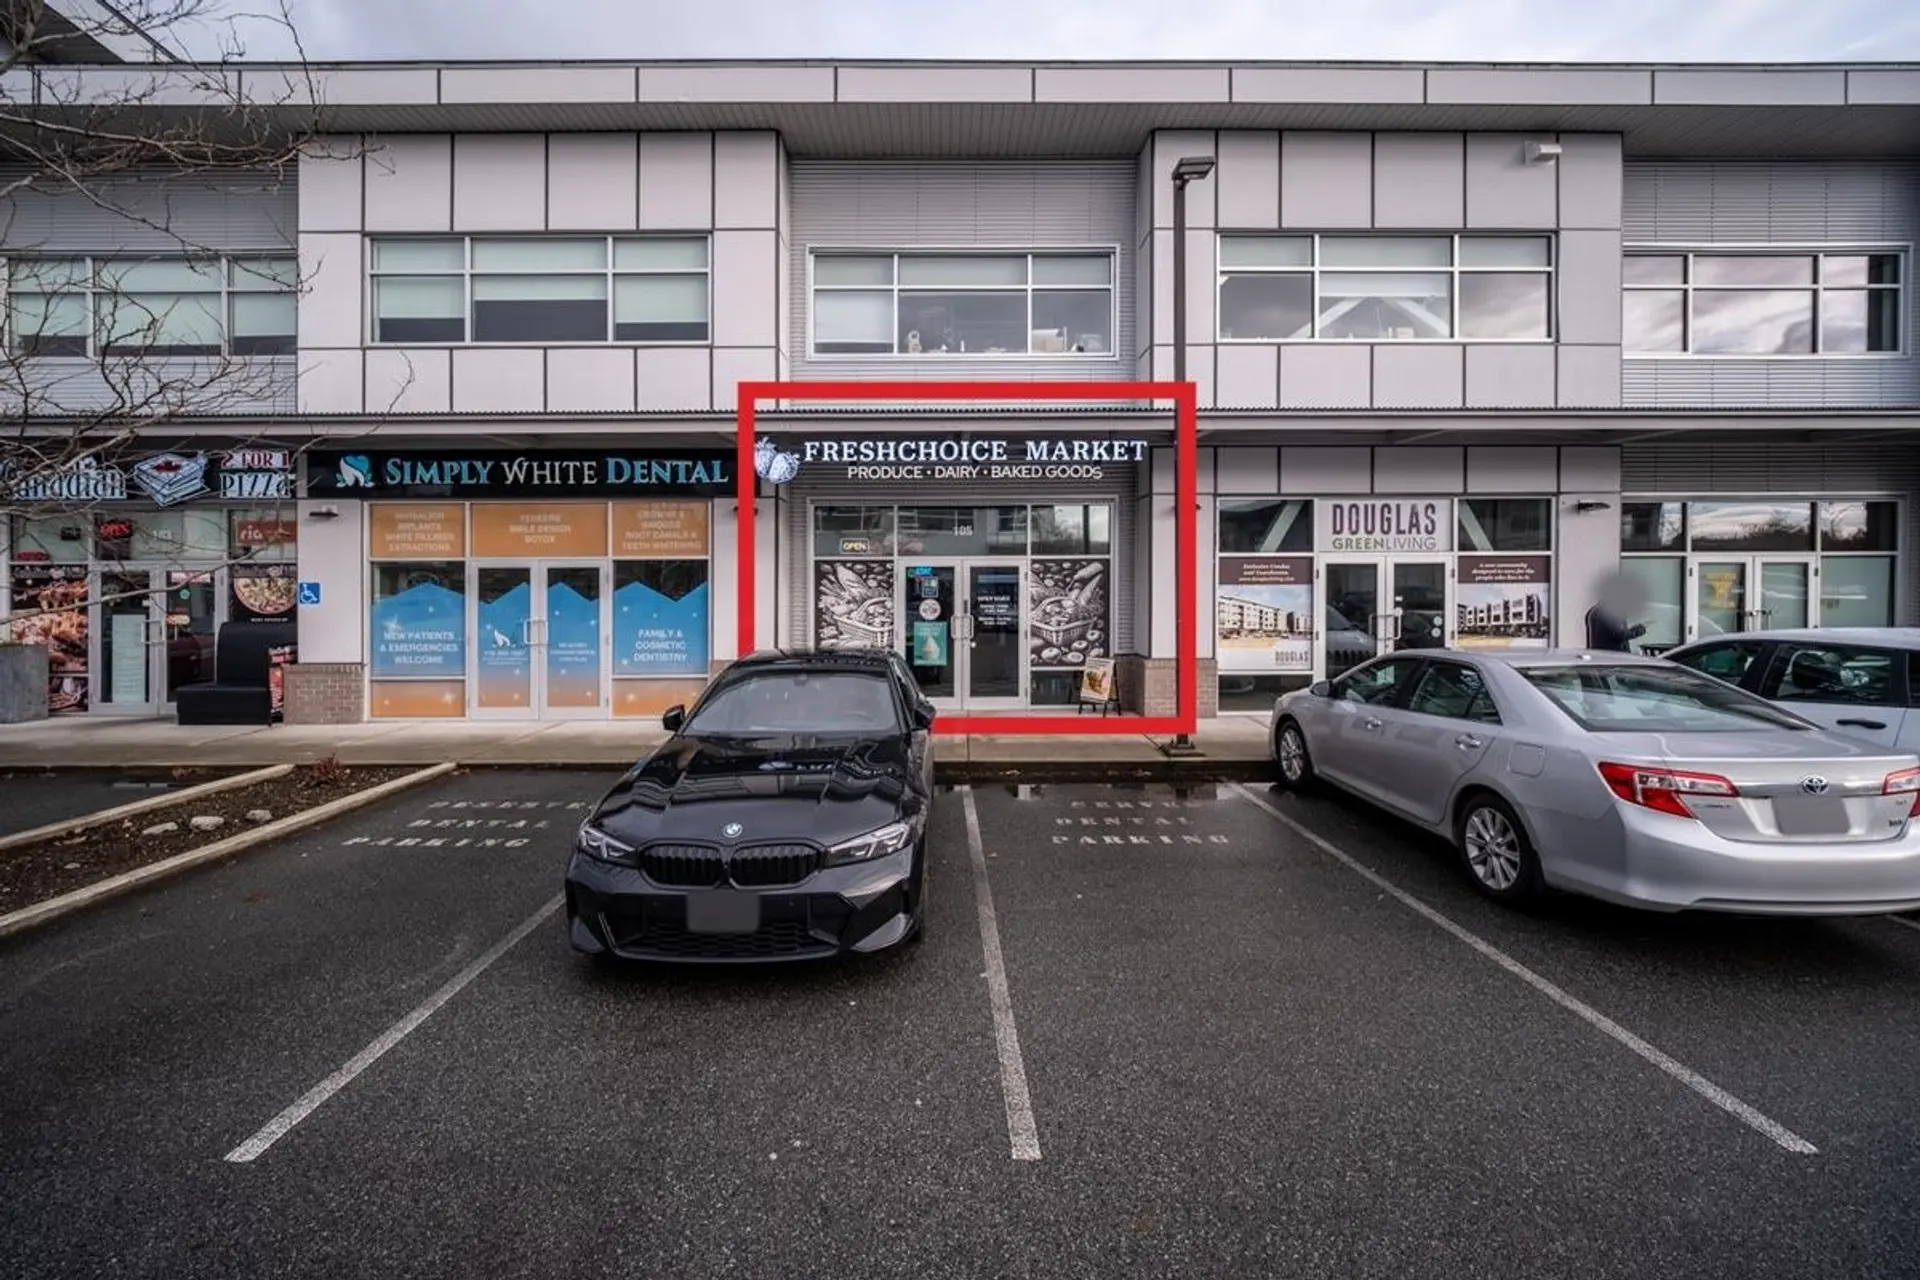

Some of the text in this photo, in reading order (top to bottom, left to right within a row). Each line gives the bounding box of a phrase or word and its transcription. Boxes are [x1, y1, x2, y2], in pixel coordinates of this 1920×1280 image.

[804, 440, 1149, 461] FRESHCHOICE MARKET
[241, 451, 273, 467] FOR
[386, 456, 729, 485] SIMPLY WHITE DENTAL
[847, 465, 1103, 480] PRODUCE DAIRY BAKED GOODS
[1331, 503, 1437, 536] DOUGLAS
[952, 525, 973, 537] 105
[843, 541, 868, 551] OPEN
[1331, 537, 1437, 550] GREENLIVING
[383, 630, 455, 640] NEW PATIENTS
[638, 629, 674, 638] FAMILY
[388, 643, 459, 652] EMERGENCIES
[635, 641, 686, 650] COSMETIC
[394, 655, 444, 664] WELCOME
[633, 653, 688, 662] DENTISTRY
